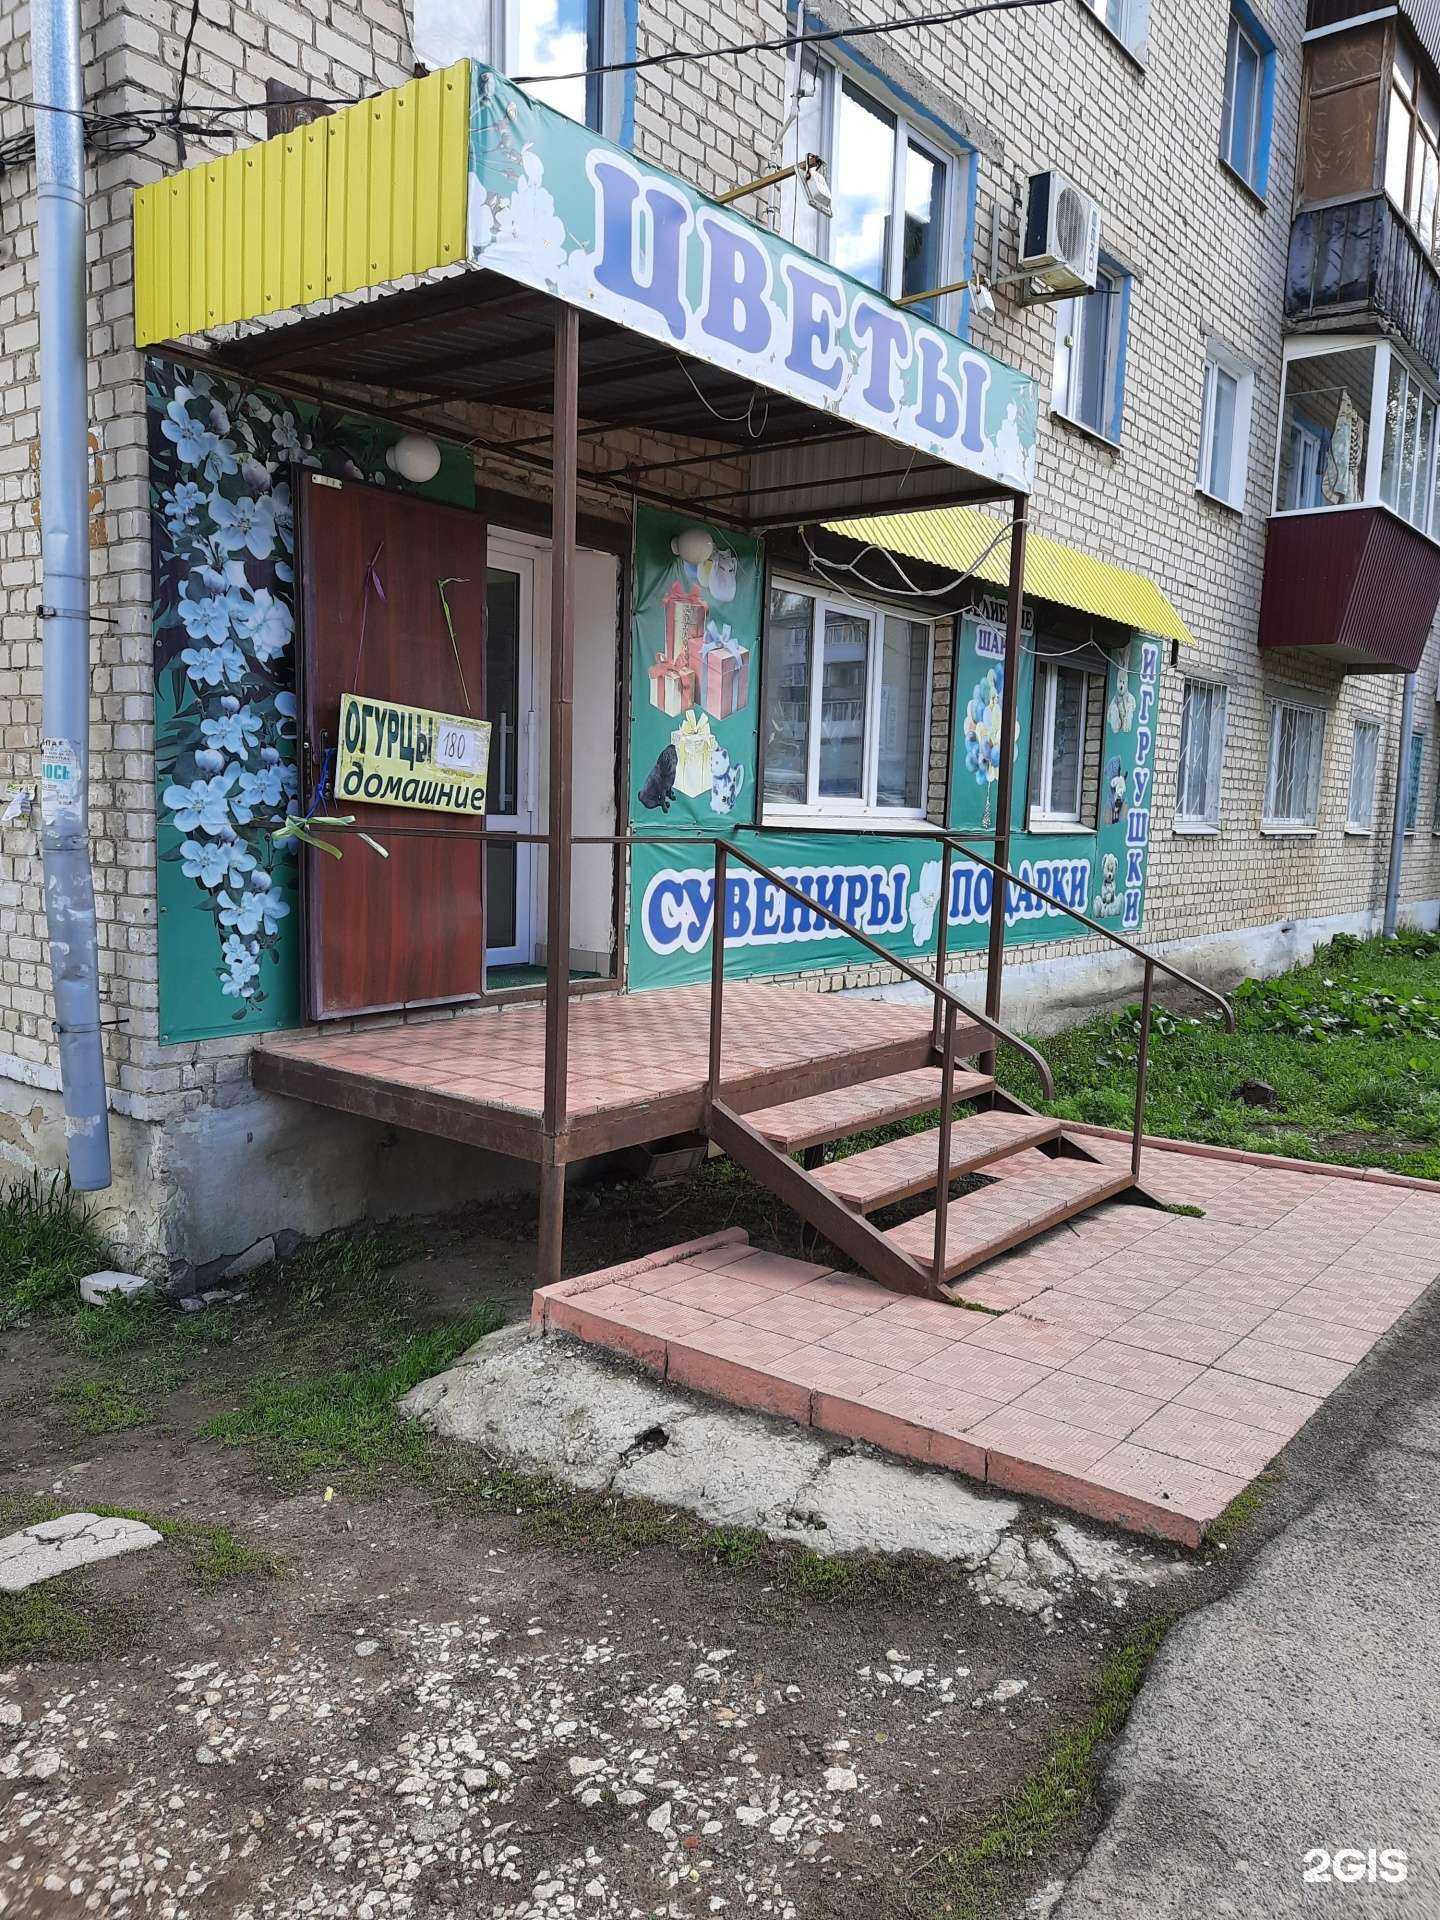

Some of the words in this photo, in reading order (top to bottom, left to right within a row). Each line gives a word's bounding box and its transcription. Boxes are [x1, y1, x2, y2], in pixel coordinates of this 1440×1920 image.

[593, 162, 988, 454] ЦВЕТЫ
[978, 629, 1012, 655] ША
[344, 700, 434, 771] ОГУРЦЫ
[443, 732, 466, 760] 180
[343, 761, 485, 811] домашние
[1125, 648, 1156, 922] ИГРУШКИ
[648, 872, 906, 945] СУВЕНИРЫ
